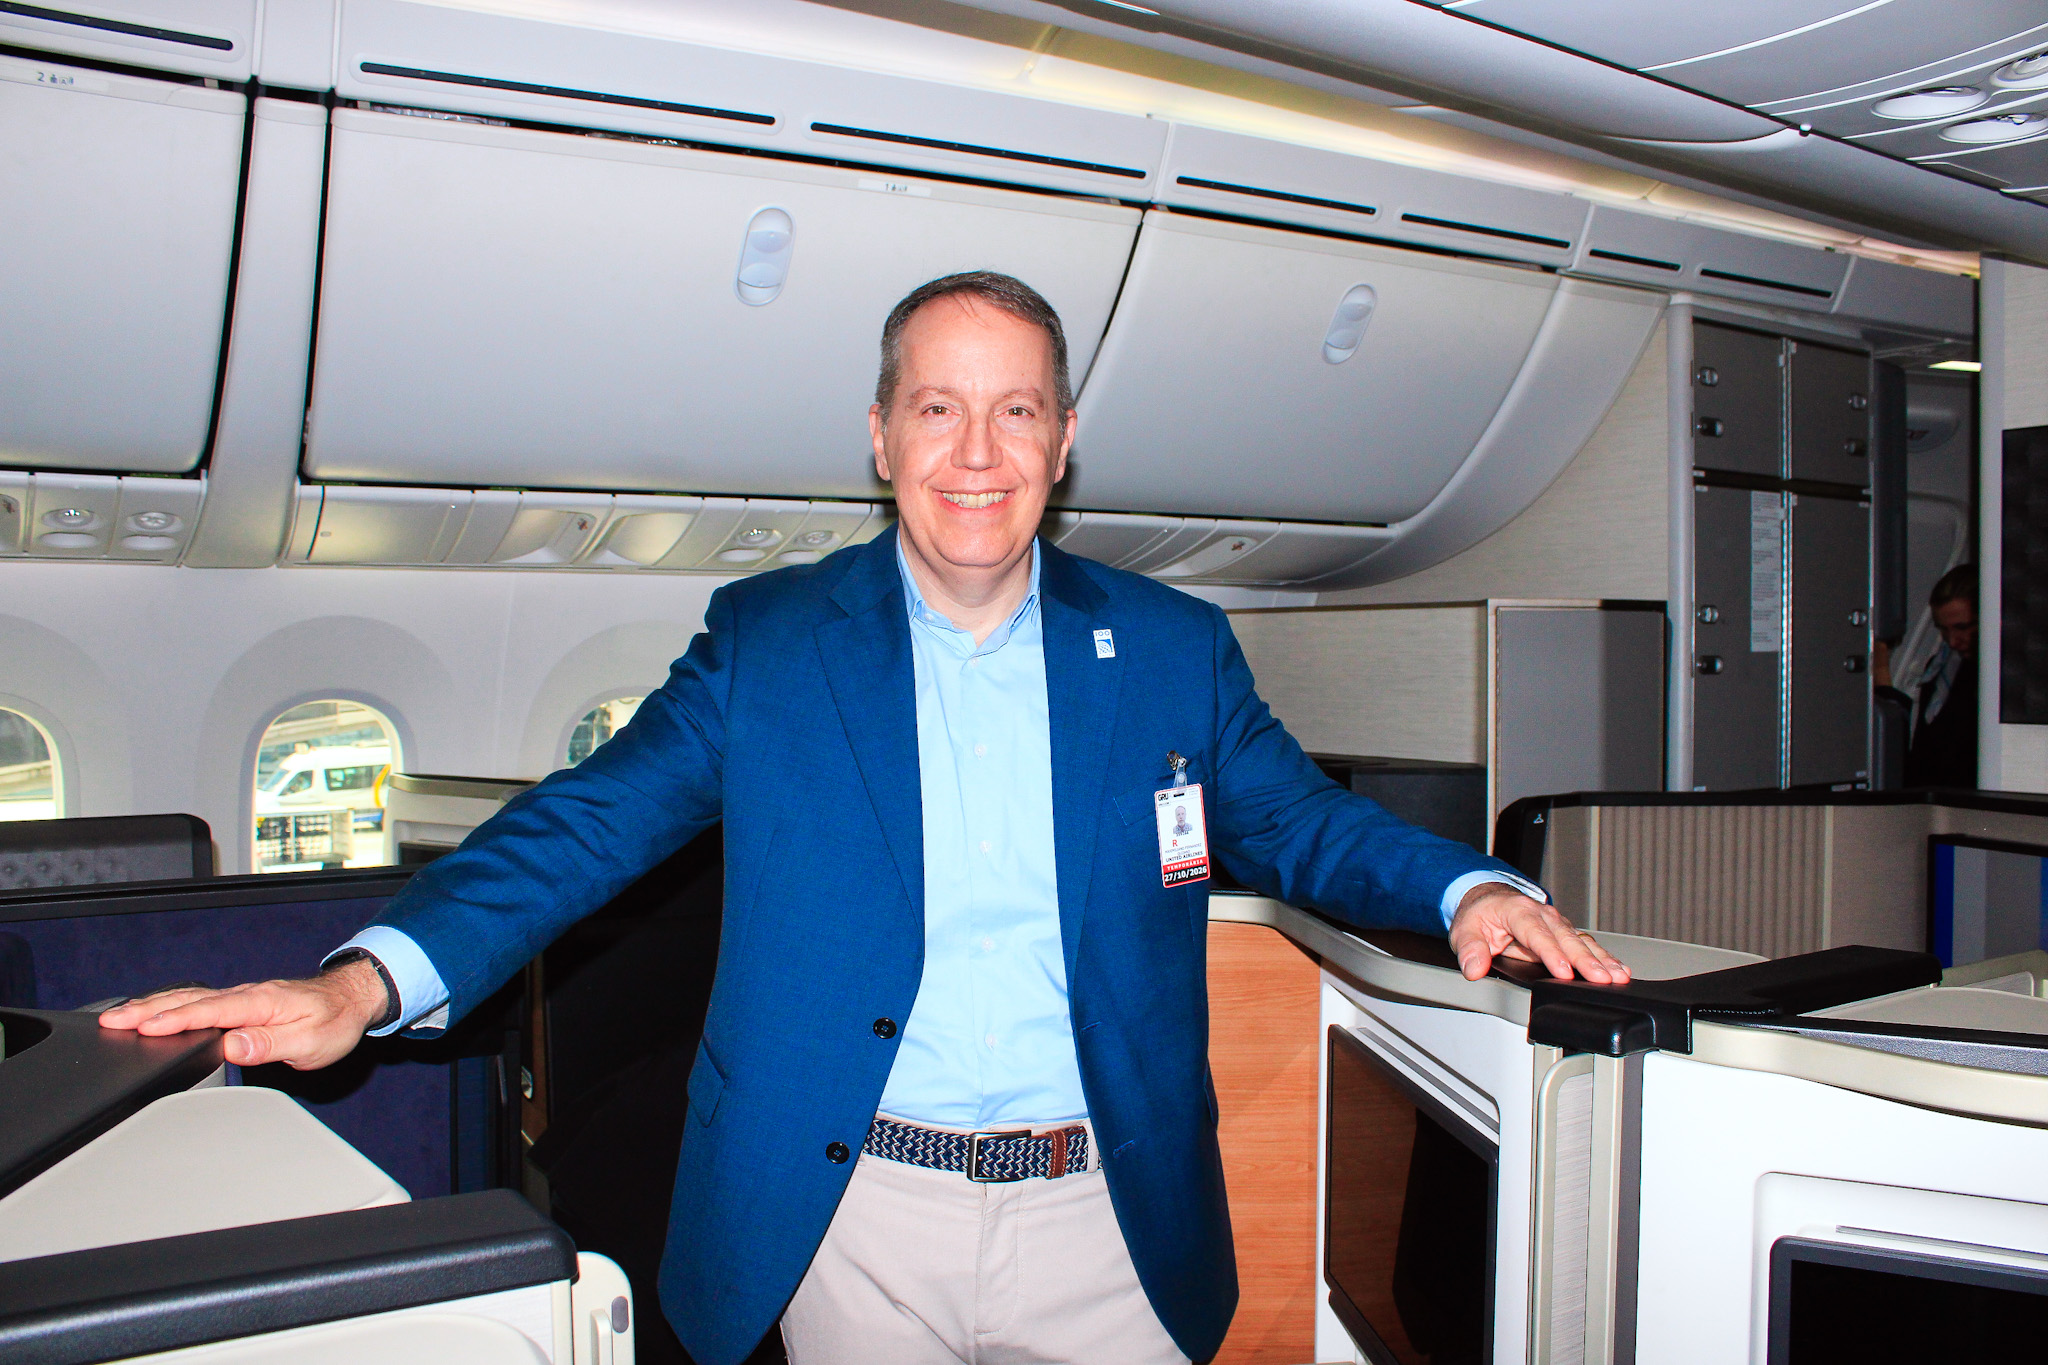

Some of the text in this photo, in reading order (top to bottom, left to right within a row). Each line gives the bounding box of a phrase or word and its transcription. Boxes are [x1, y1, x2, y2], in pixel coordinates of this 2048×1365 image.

[37, 72, 45, 82] 2
[1158, 792, 1169, 801] GRU
[1172, 839, 1178, 847] R
[1183, 851, 1204, 859] AIRLINES
[1164, 865, 1207, 882] 27/10/2026
